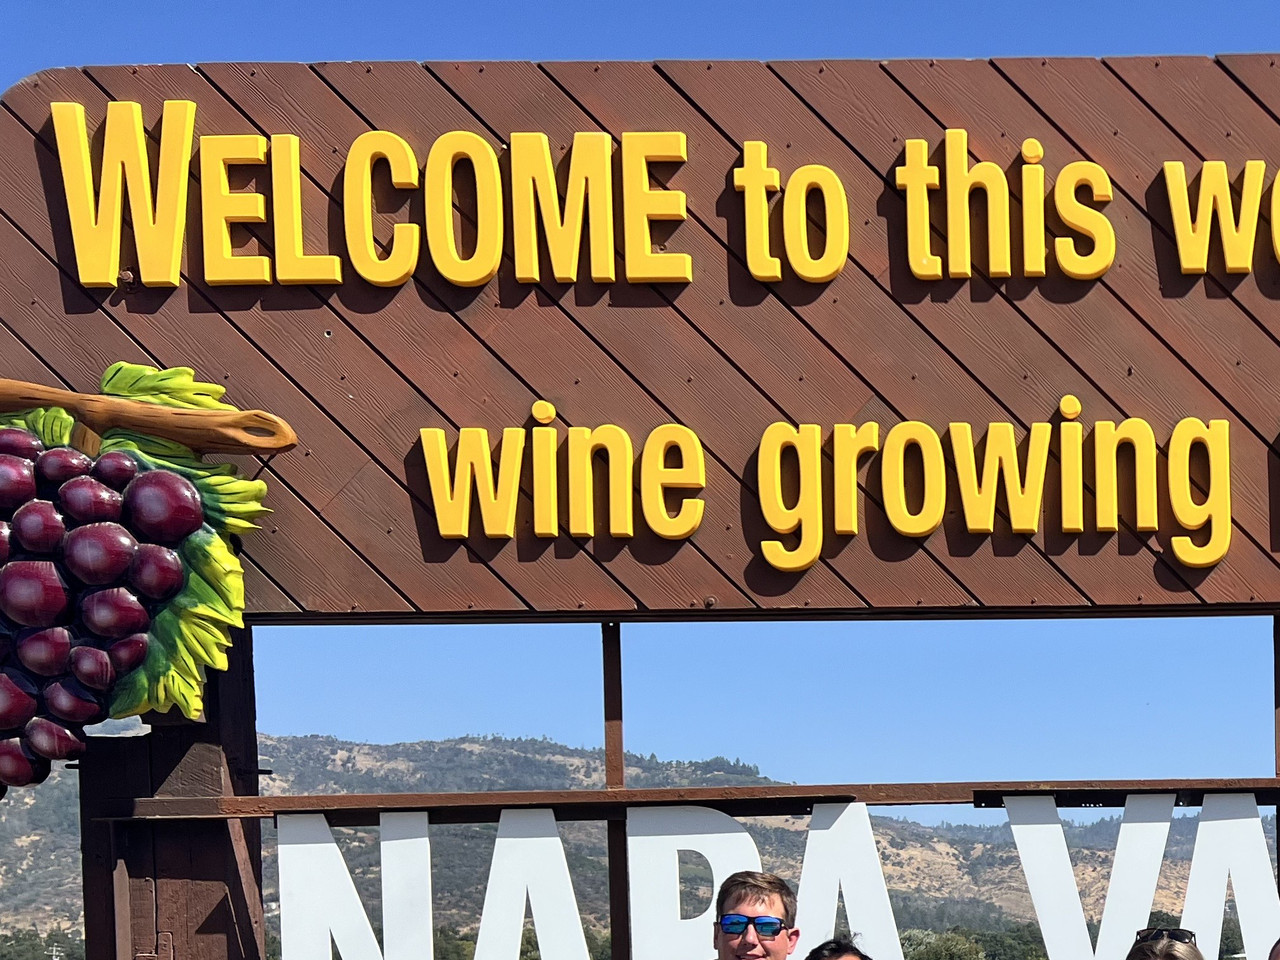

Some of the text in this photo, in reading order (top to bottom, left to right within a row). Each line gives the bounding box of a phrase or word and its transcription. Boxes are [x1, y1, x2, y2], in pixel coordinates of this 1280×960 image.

[51, 100, 693, 288] WELCOME
[734, 140, 850, 282] to
[896, 131, 1115, 280] this
[419, 401, 706, 540] wine
[757, 395, 1231, 571] growing
